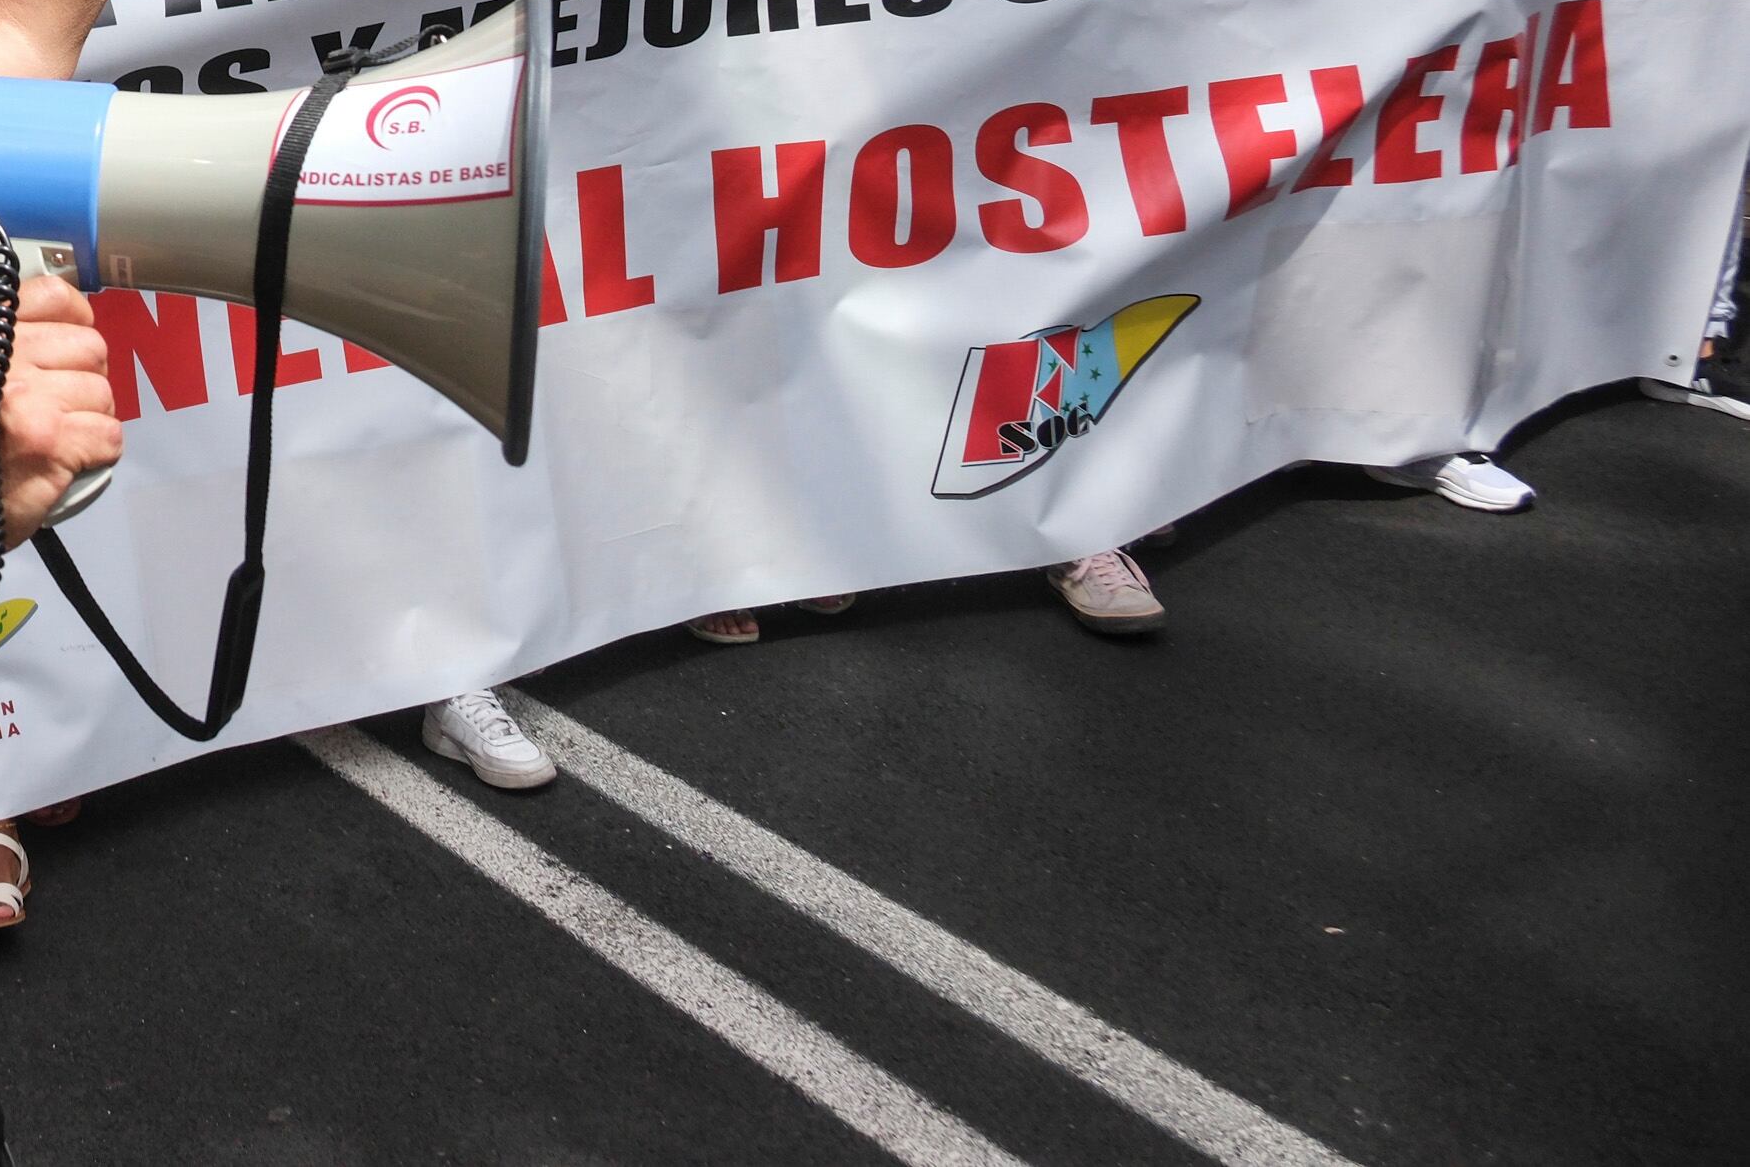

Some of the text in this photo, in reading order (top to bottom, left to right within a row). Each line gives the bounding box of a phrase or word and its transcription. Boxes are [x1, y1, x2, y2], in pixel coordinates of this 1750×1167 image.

[388, 120, 426, 135] S.B.
[298, 162, 507, 186] NDICALISTAS DE BASE
